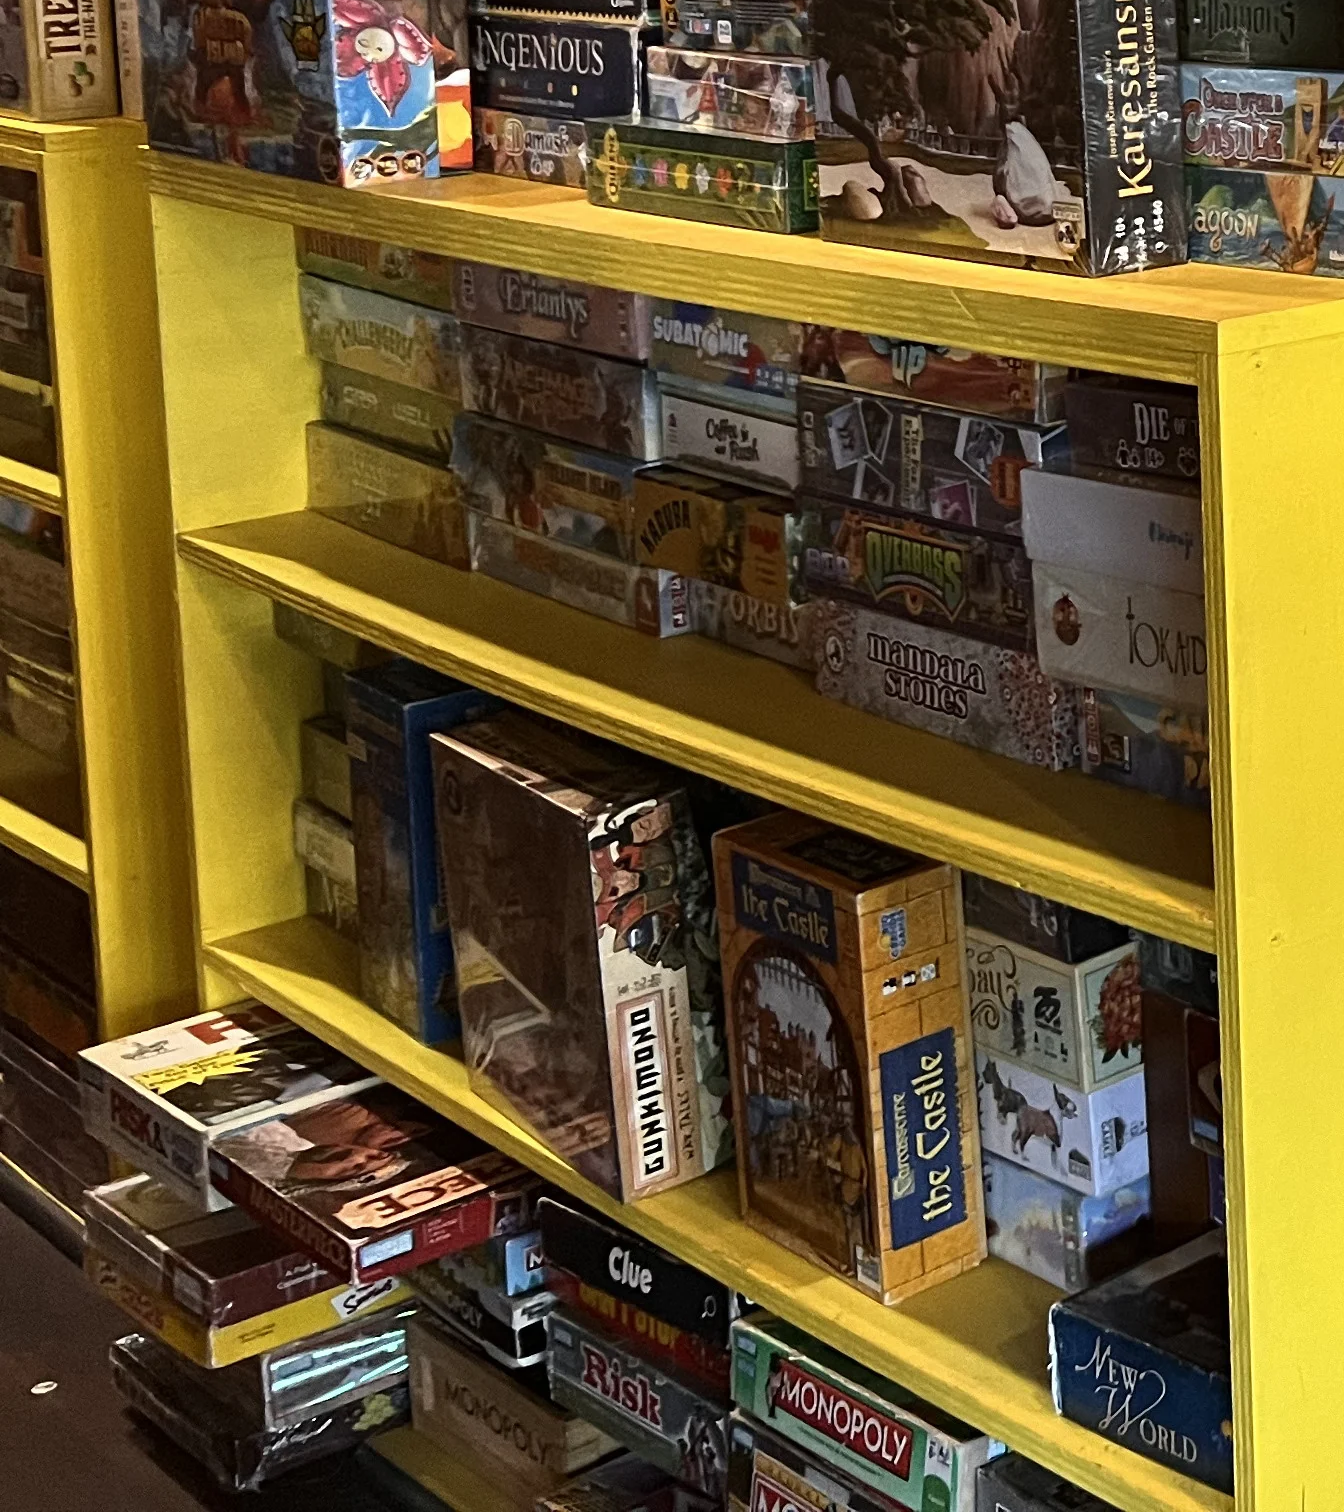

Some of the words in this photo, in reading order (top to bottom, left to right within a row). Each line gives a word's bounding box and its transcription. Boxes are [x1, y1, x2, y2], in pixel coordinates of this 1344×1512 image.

[82, 13, 98, 40] THE
[864, 526, 968, 594] OVERBOSS
[634, 1005, 664, 1180] GUNKIMONO
[914, 1050, 946, 1155] Castle
[922, 1168, 956, 1222] the
[608, 1245, 654, 1294] Clue
[580, 1342, 662, 1432] Risk
[779, 1368, 909, 1467] MONOPOLY
